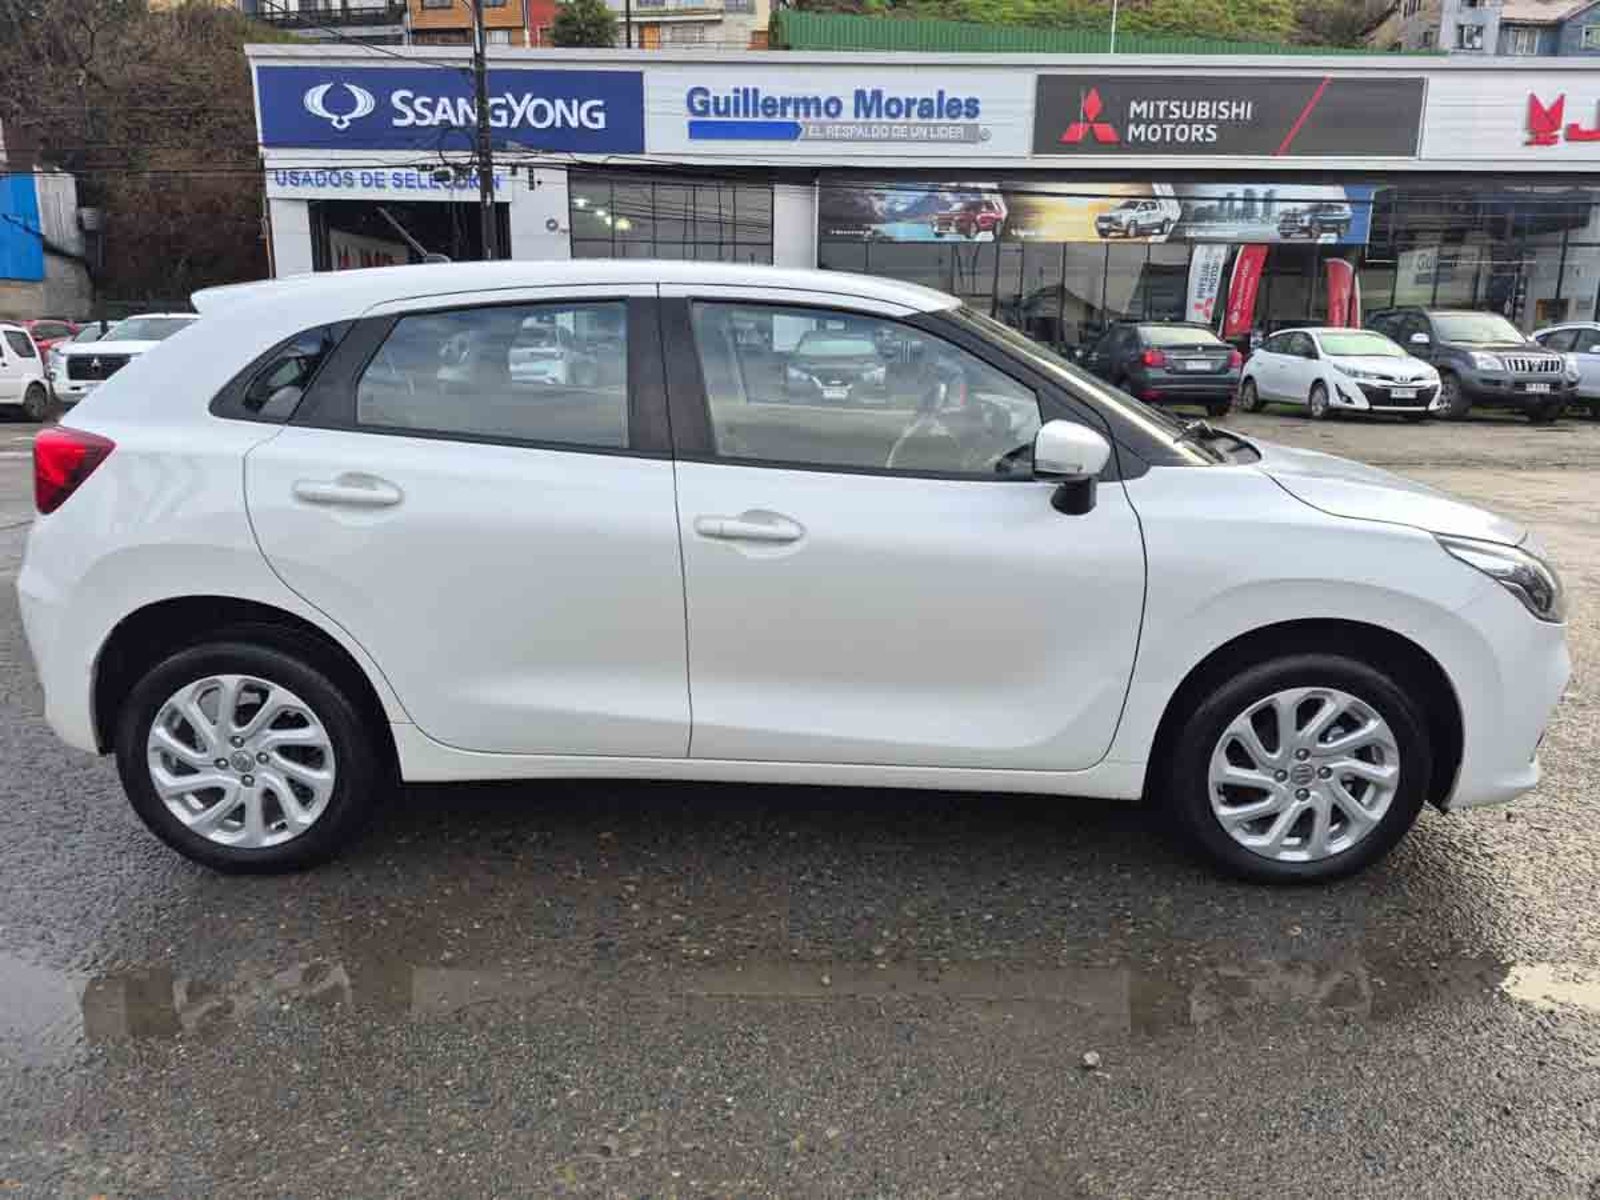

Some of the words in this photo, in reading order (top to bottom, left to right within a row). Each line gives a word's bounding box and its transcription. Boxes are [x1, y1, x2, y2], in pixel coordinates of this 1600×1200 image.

[687, 87, 843, 118] Guillermo
[853, 89, 981, 119] Morales
[1129, 100, 1252, 120] MITSUBISHI
[1127, 123, 1217, 142] MOTORS
[275, 170, 353, 188] USADOS
[361, 172, 385, 189] DE
